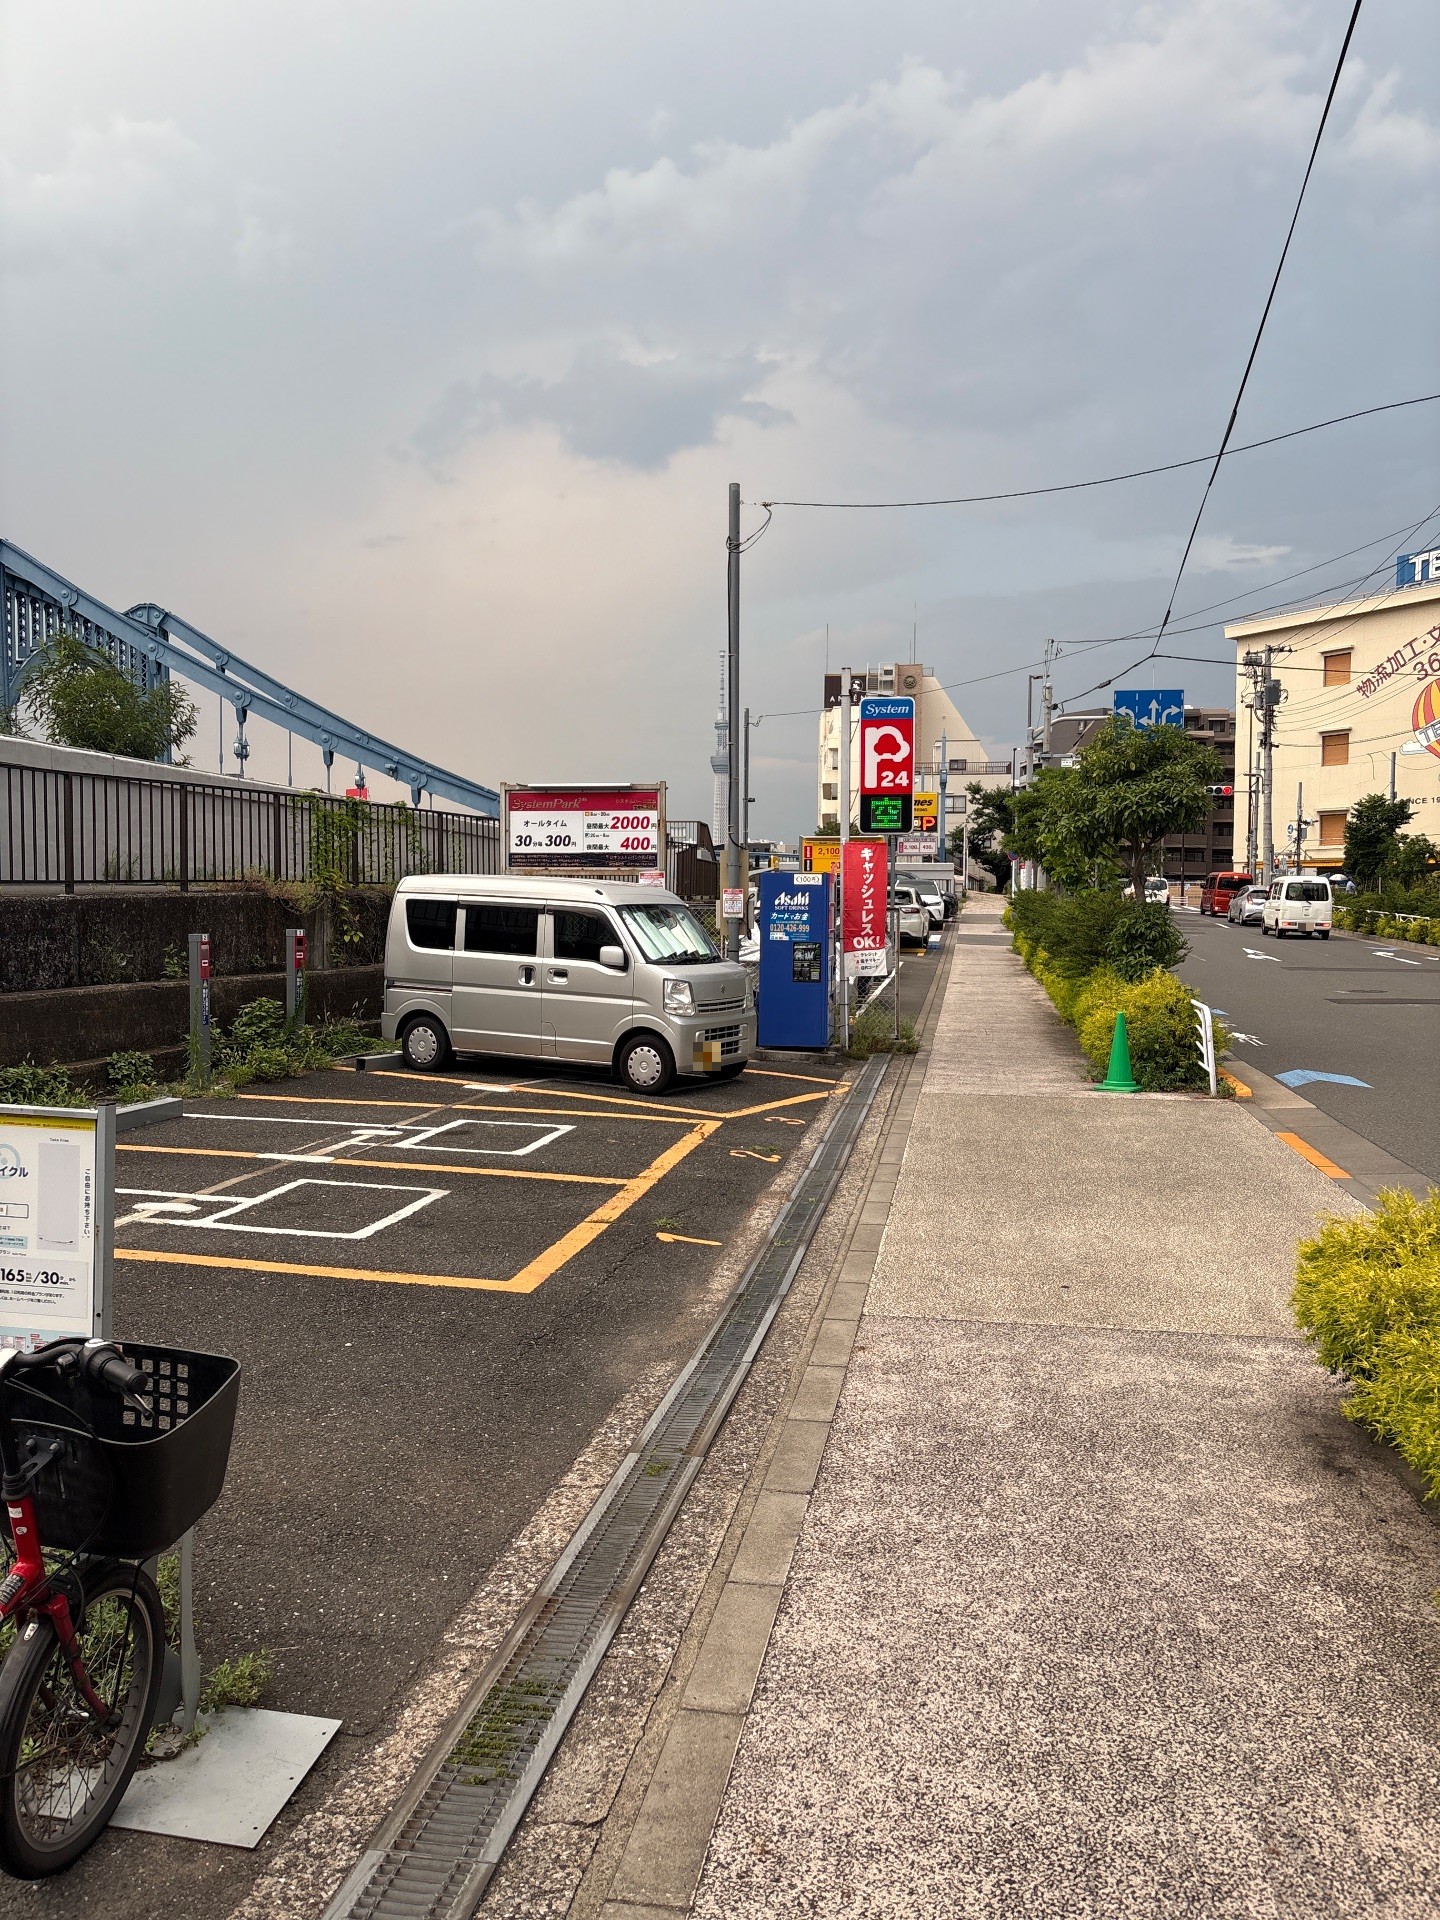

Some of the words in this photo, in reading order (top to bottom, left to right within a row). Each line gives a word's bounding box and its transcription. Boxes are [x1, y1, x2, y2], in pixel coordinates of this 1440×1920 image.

[865, 703, 909, 716] System
[881, 770, 909, 787] 24
[512, 798, 580, 810] SystemPark
[609, 816, 657, 830] 2000円
[922, 816, 936, 830] P
[545, 835, 576, 847] 300円
[620, 837, 657, 850] 400円
[860, 847, 874, 935] キャッシュレス
[774, 891, 810, 906] Asahi
[853, 935, 880, 949] OK!
